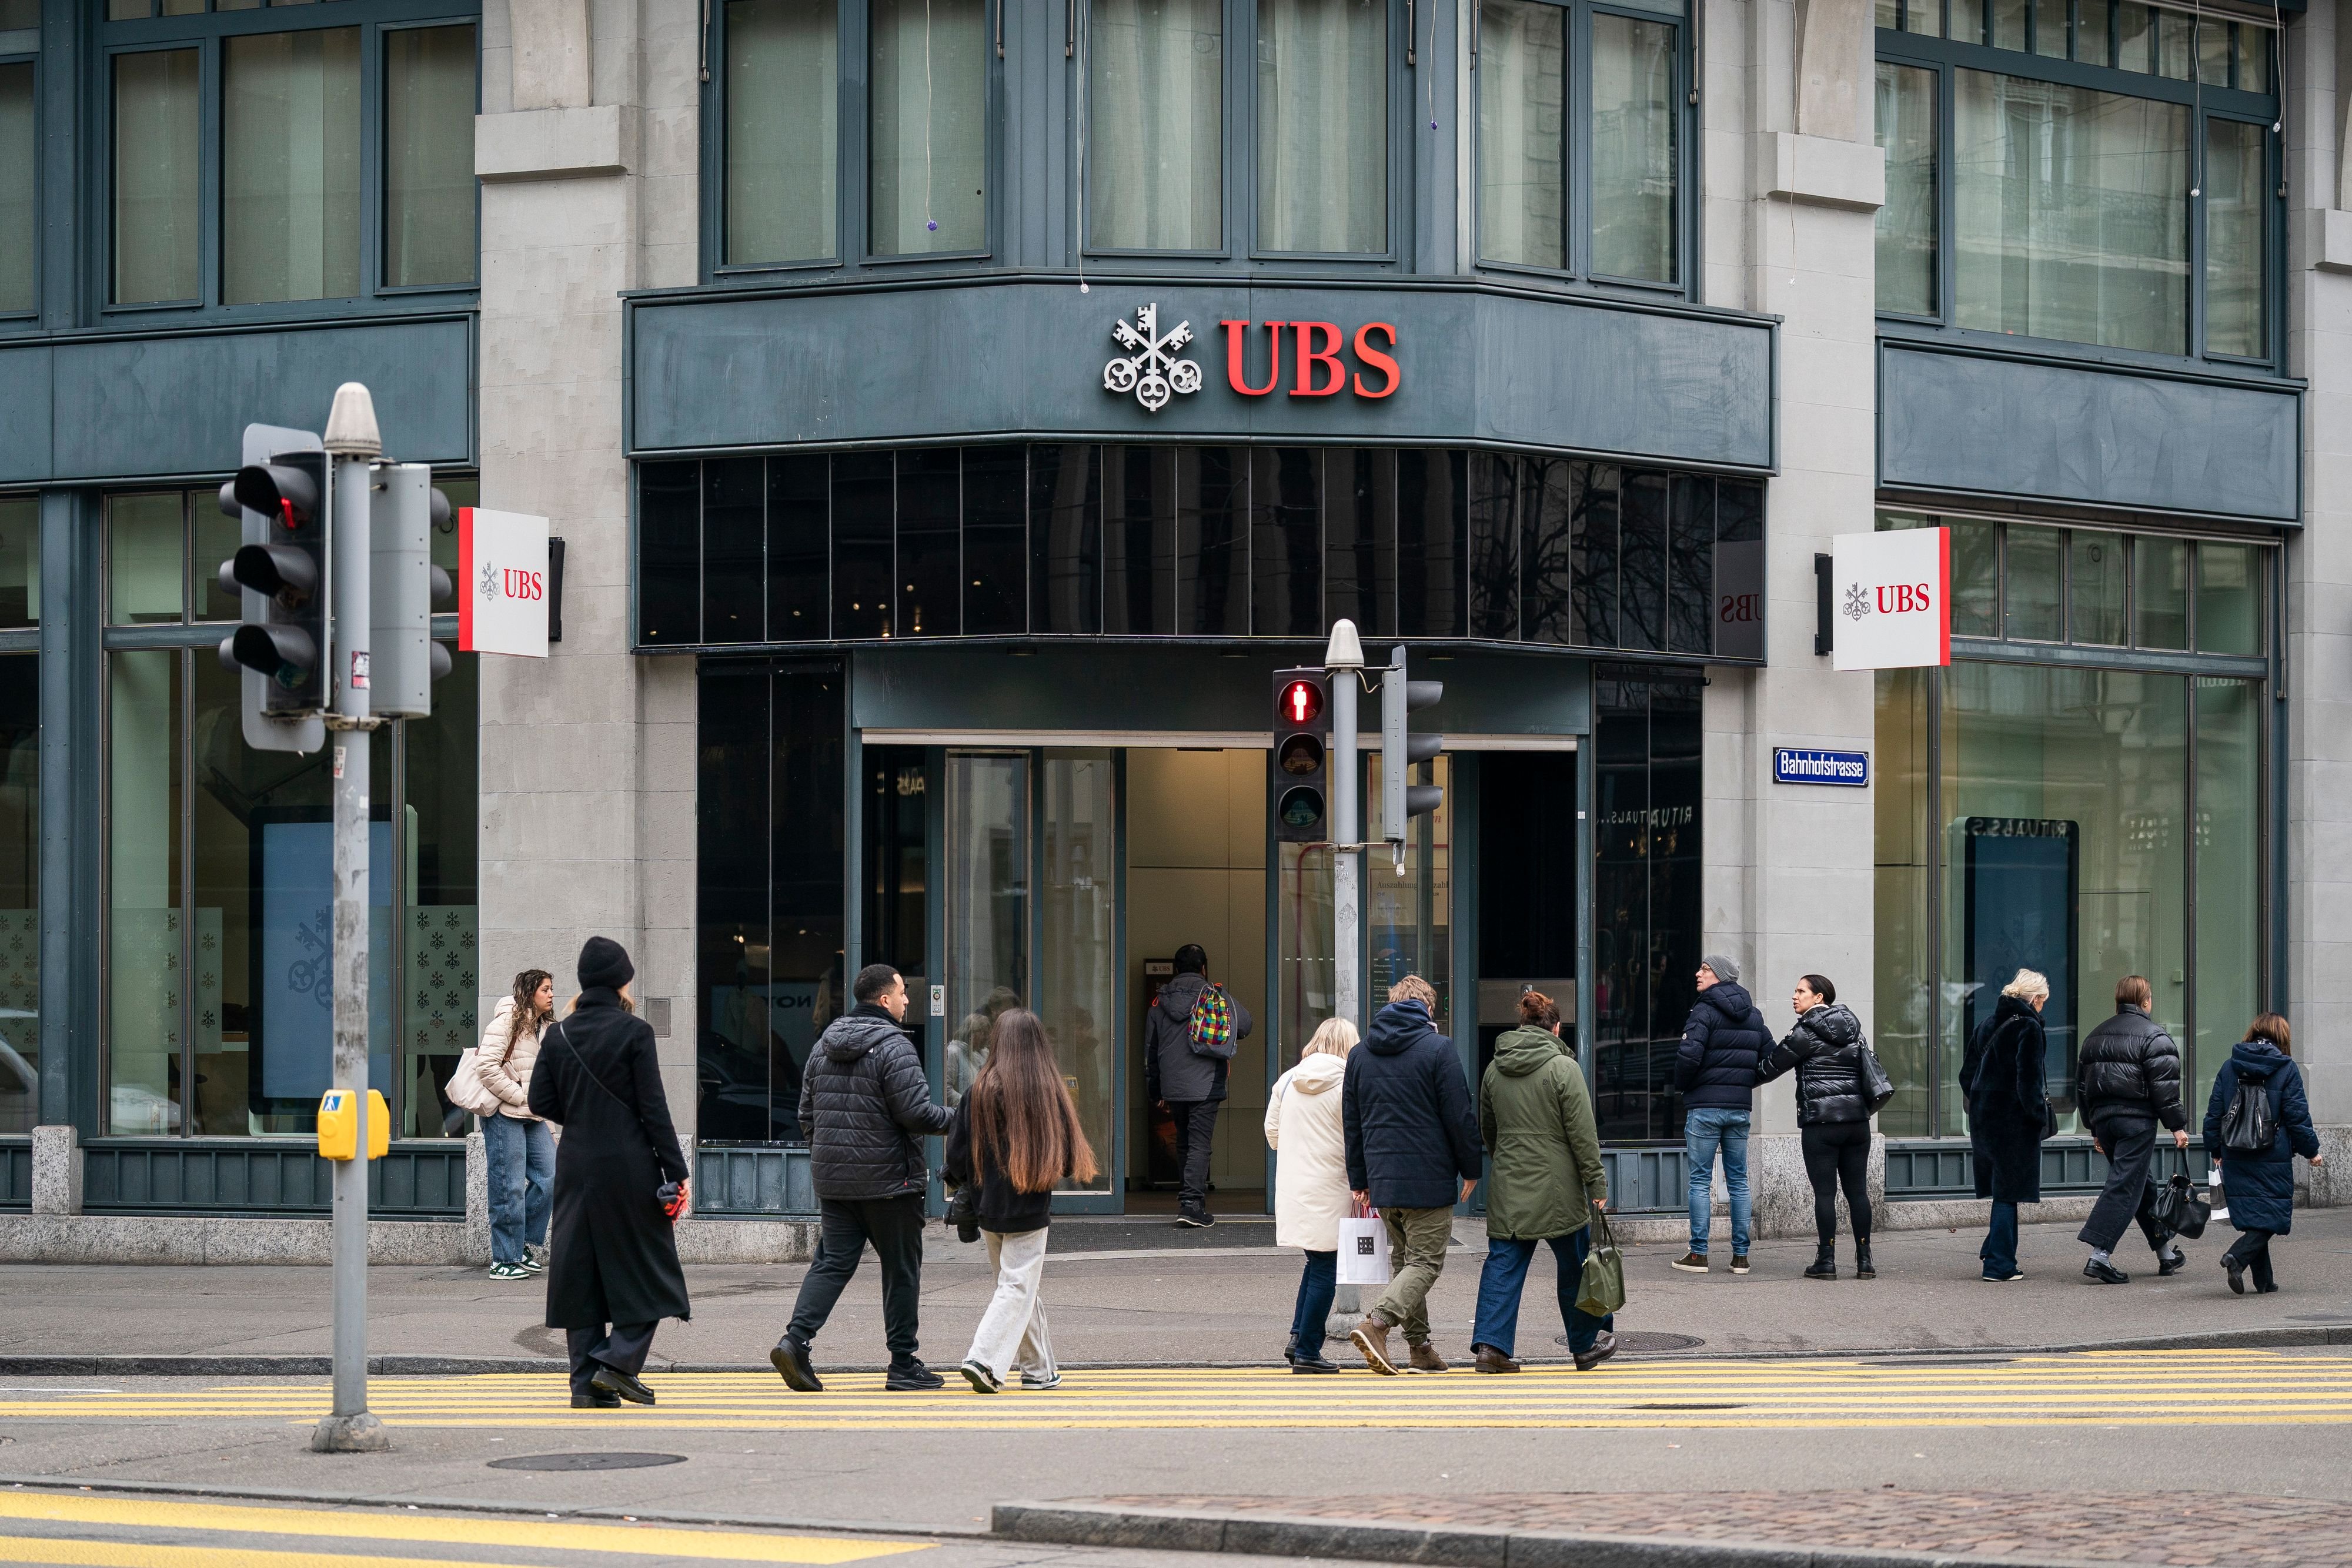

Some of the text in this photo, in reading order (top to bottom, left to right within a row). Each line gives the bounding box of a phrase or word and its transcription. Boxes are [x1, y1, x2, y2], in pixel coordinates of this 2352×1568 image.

[1220, 320, 1400, 398] UBS
[503, 569, 542, 601] UBS
[1876, 583, 1930, 613] UBS
[1781, 752, 1863, 777] Bahnhofstrasse
[1378, 881, 1417, 890] Auszahlung
